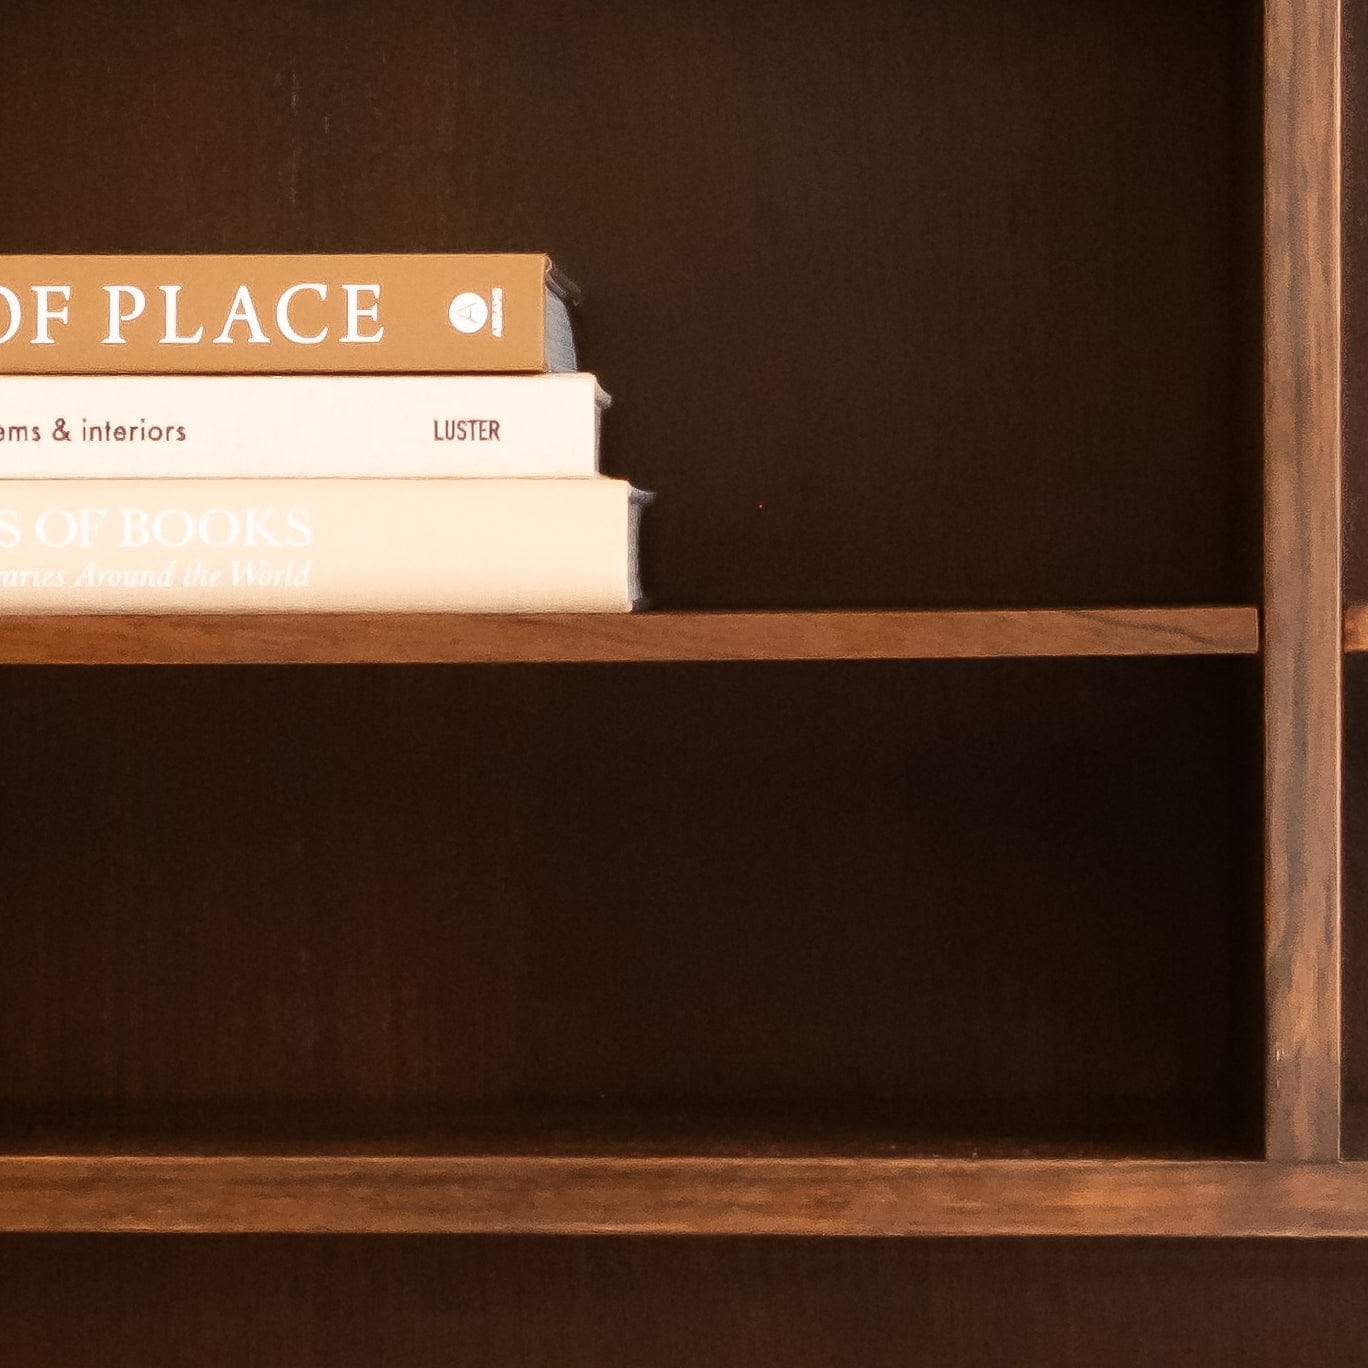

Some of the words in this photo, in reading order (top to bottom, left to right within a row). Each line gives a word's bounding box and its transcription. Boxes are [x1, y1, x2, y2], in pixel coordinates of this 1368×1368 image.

[100, 283, 385, 346] PLACE
[51, 418, 72, 443] &
[81, 417, 187, 443] interiors
[432, 419, 501, 442] LUSTER
[34, 507, 109, 550] OF
[120, 507, 314, 550] BOOKS
[75, 559, 175, 589] Around
[182, 559, 223, 588] the
[230, 558, 314, 588] World
